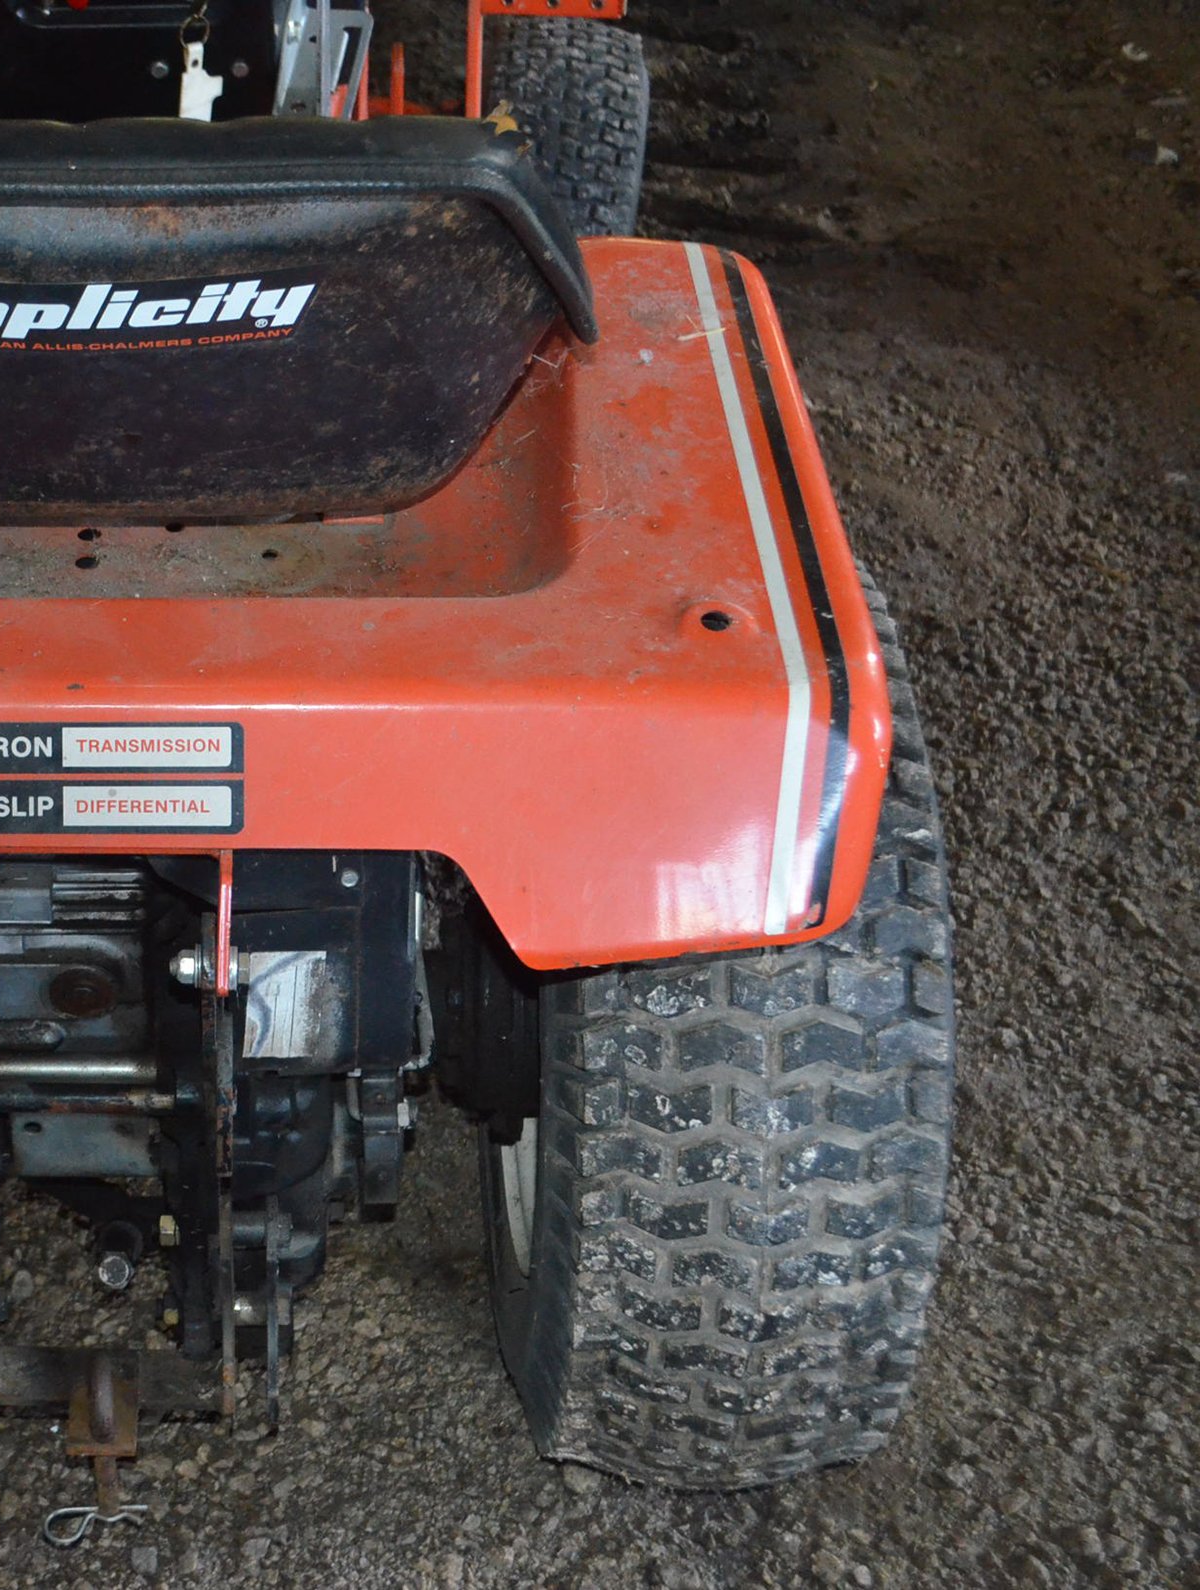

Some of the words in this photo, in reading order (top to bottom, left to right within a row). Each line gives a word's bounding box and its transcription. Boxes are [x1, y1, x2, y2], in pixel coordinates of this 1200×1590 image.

[0, 341, 27, 350] AN
[32, 337, 193, 351] ALLIS-CHALMERS
[197, 327, 294, 345] COMPANY
[76, 738, 221, 753] TRANSMISSION
[76, 799, 211, 814] DIFFERENTIAL
